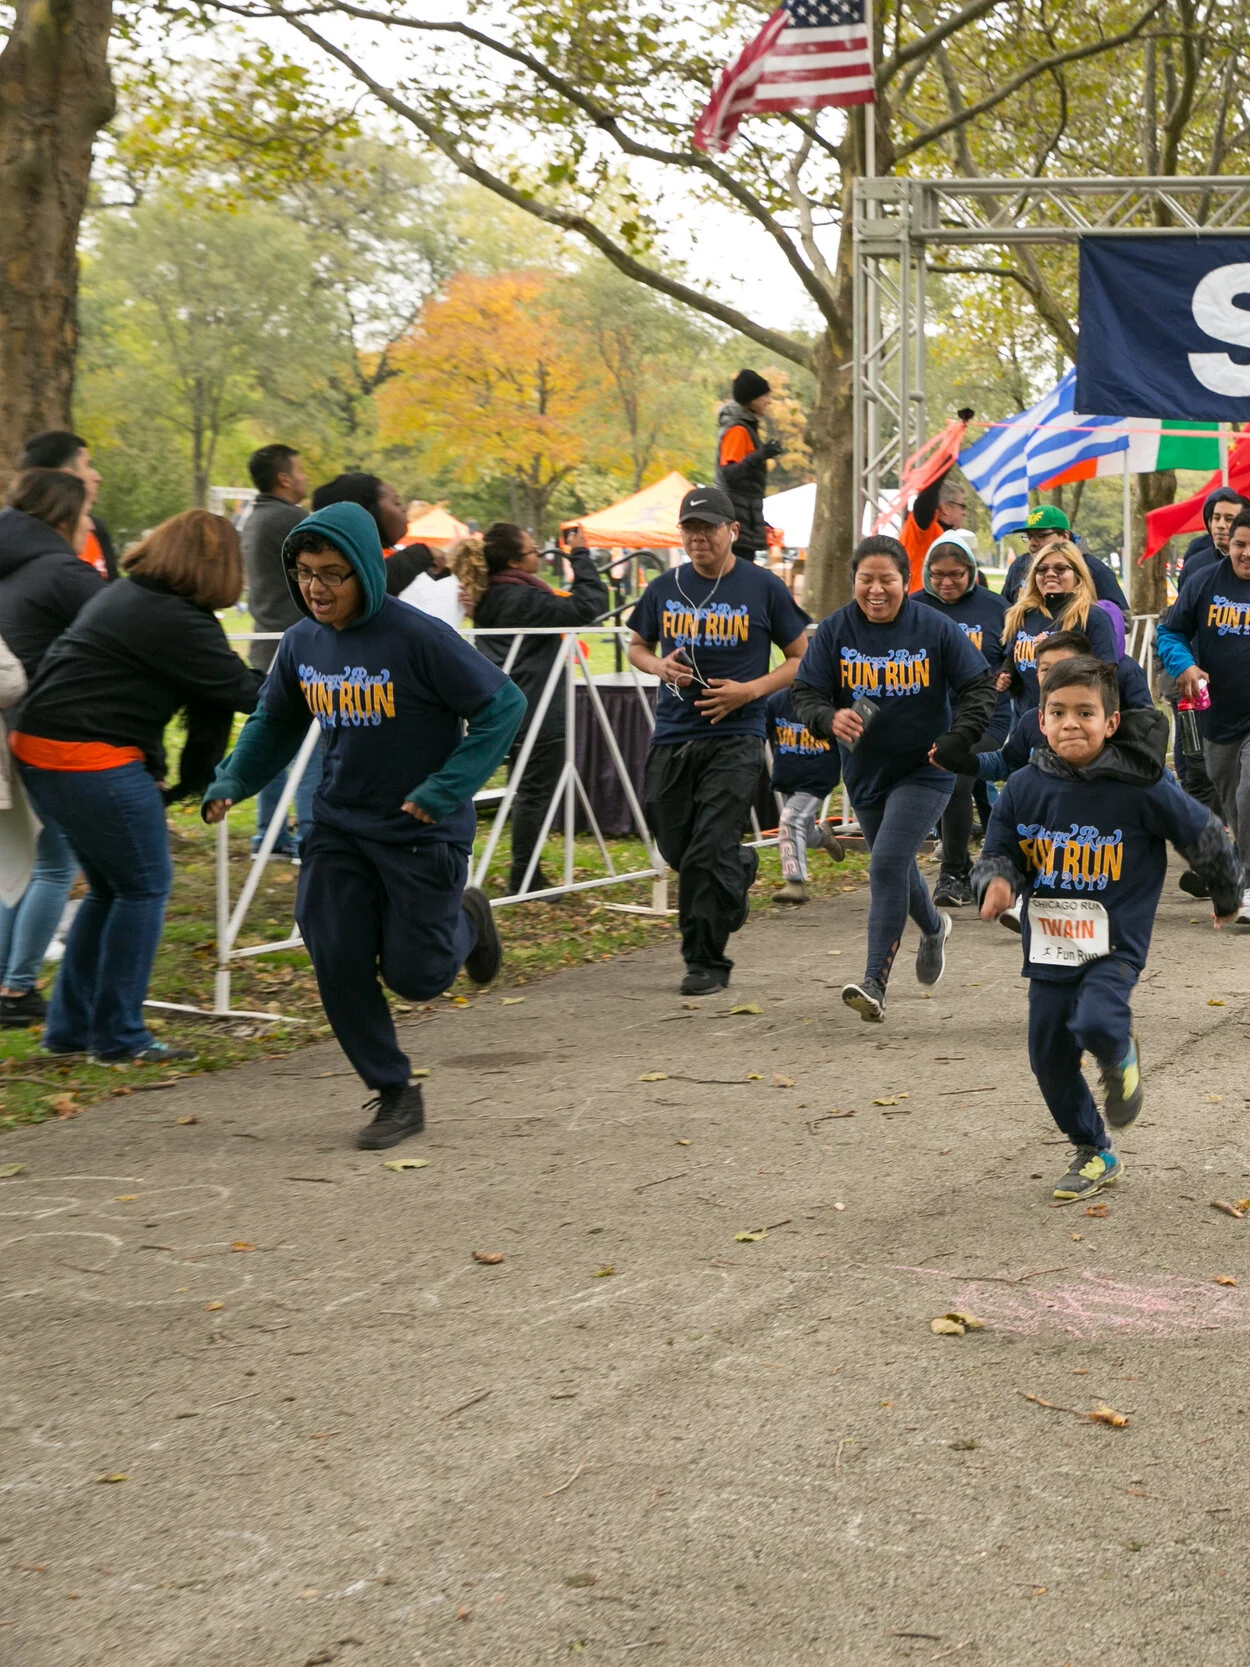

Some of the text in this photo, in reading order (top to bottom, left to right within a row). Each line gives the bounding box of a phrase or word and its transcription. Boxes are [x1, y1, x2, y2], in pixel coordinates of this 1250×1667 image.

[662, 611, 749, 641] FUN RUN
[1207, 604, 1240, 629] FUN
[704, 635, 739, 648] 2019
[841, 646, 927, 669] Chicago Run
[840, 658, 930, 690] FUN RUN
[340, 681, 396, 718] RUN
[852, 682, 921, 700] Fall 2019
[340, 710, 382, 727] 2019
[1017, 823, 1123, 852] Chicago Run
[1063, 840, 1124, 883] RUN
[1060, 871, 1109, 891] 2019
[1032, 900, 1103, 911] CHICAGO RUN
[1038, 917, 1094, 939] TWAIN
[1056, 946, 1099, 962] Fun Run
